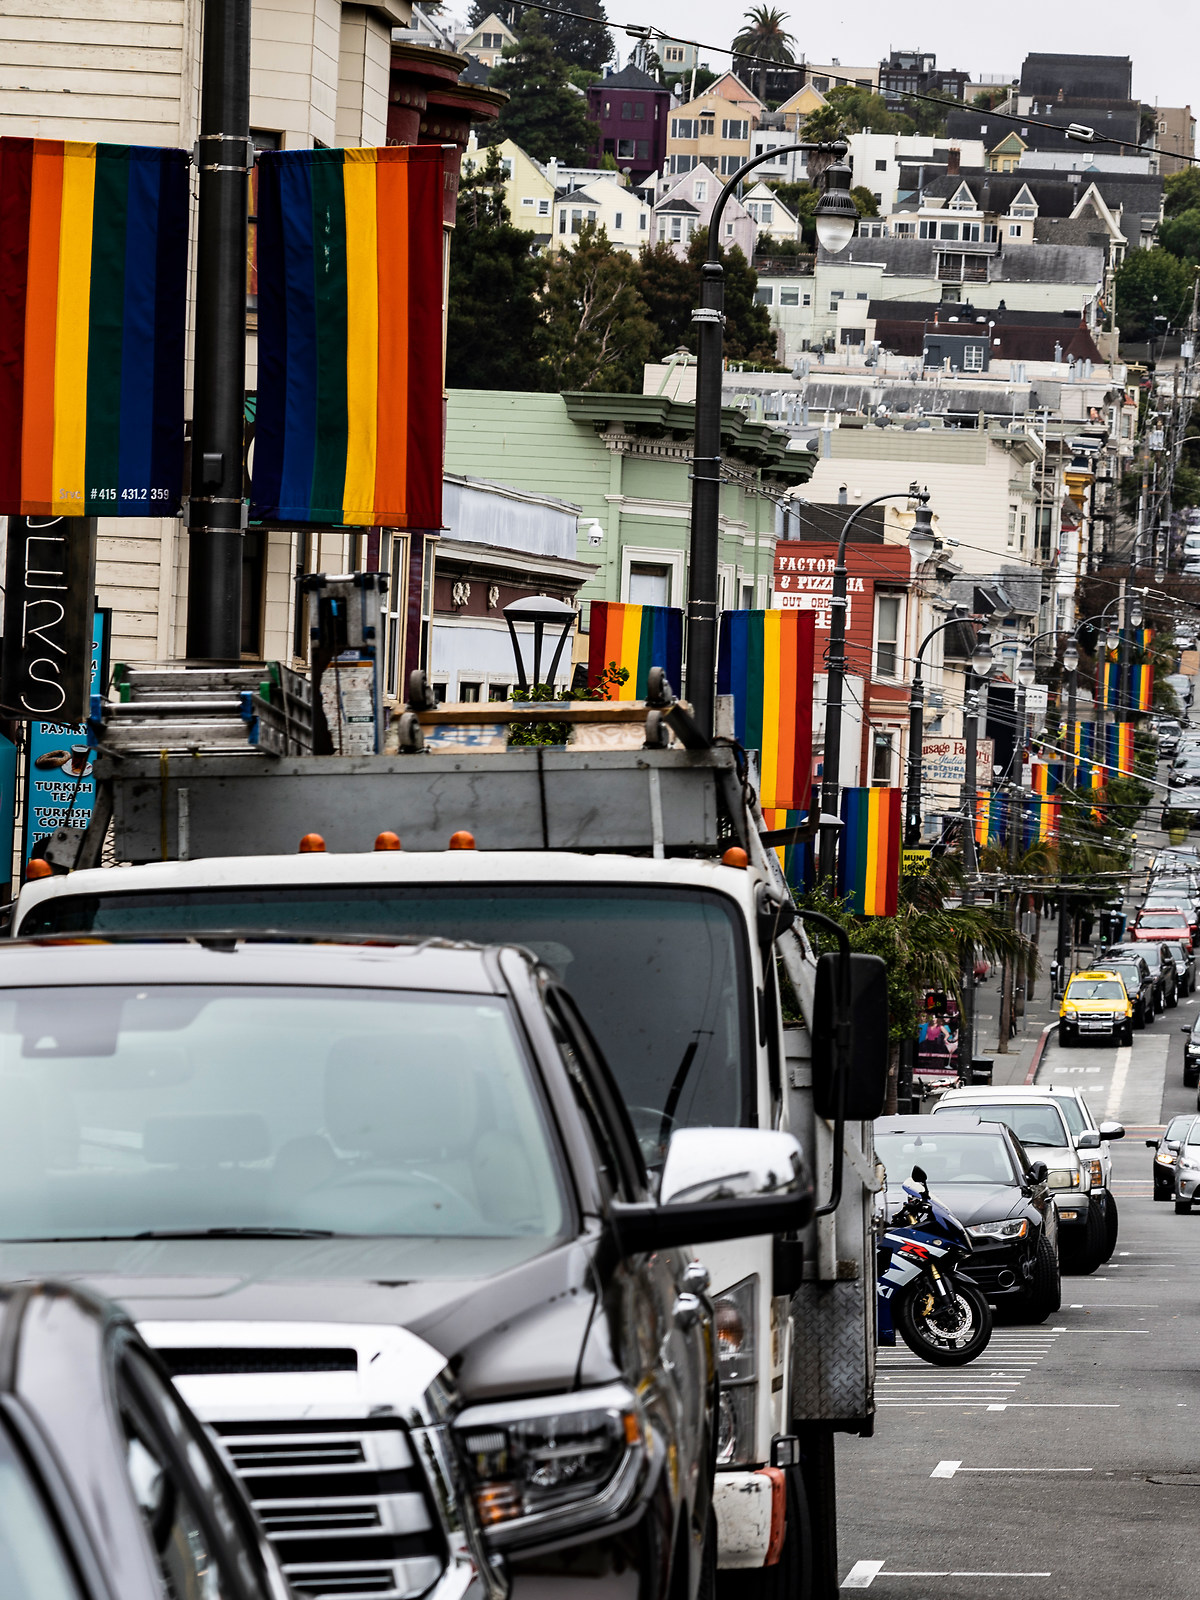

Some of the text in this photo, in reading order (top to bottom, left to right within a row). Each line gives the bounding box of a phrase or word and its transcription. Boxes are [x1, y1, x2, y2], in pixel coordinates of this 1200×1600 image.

[779, 557, 847, 573] FACTOR
[781, 575, 864, 592] & PIZZIA
[783, 597, 802, 607] OUT
[921, 764, 965, 773] RESTAURA
[34, 781, 92, 793] TURKISH
[50, 792, 76, 802] TEA
[33, 807, 91, 819] TURKISH
[38, 817, 87, 829] COFFEE
